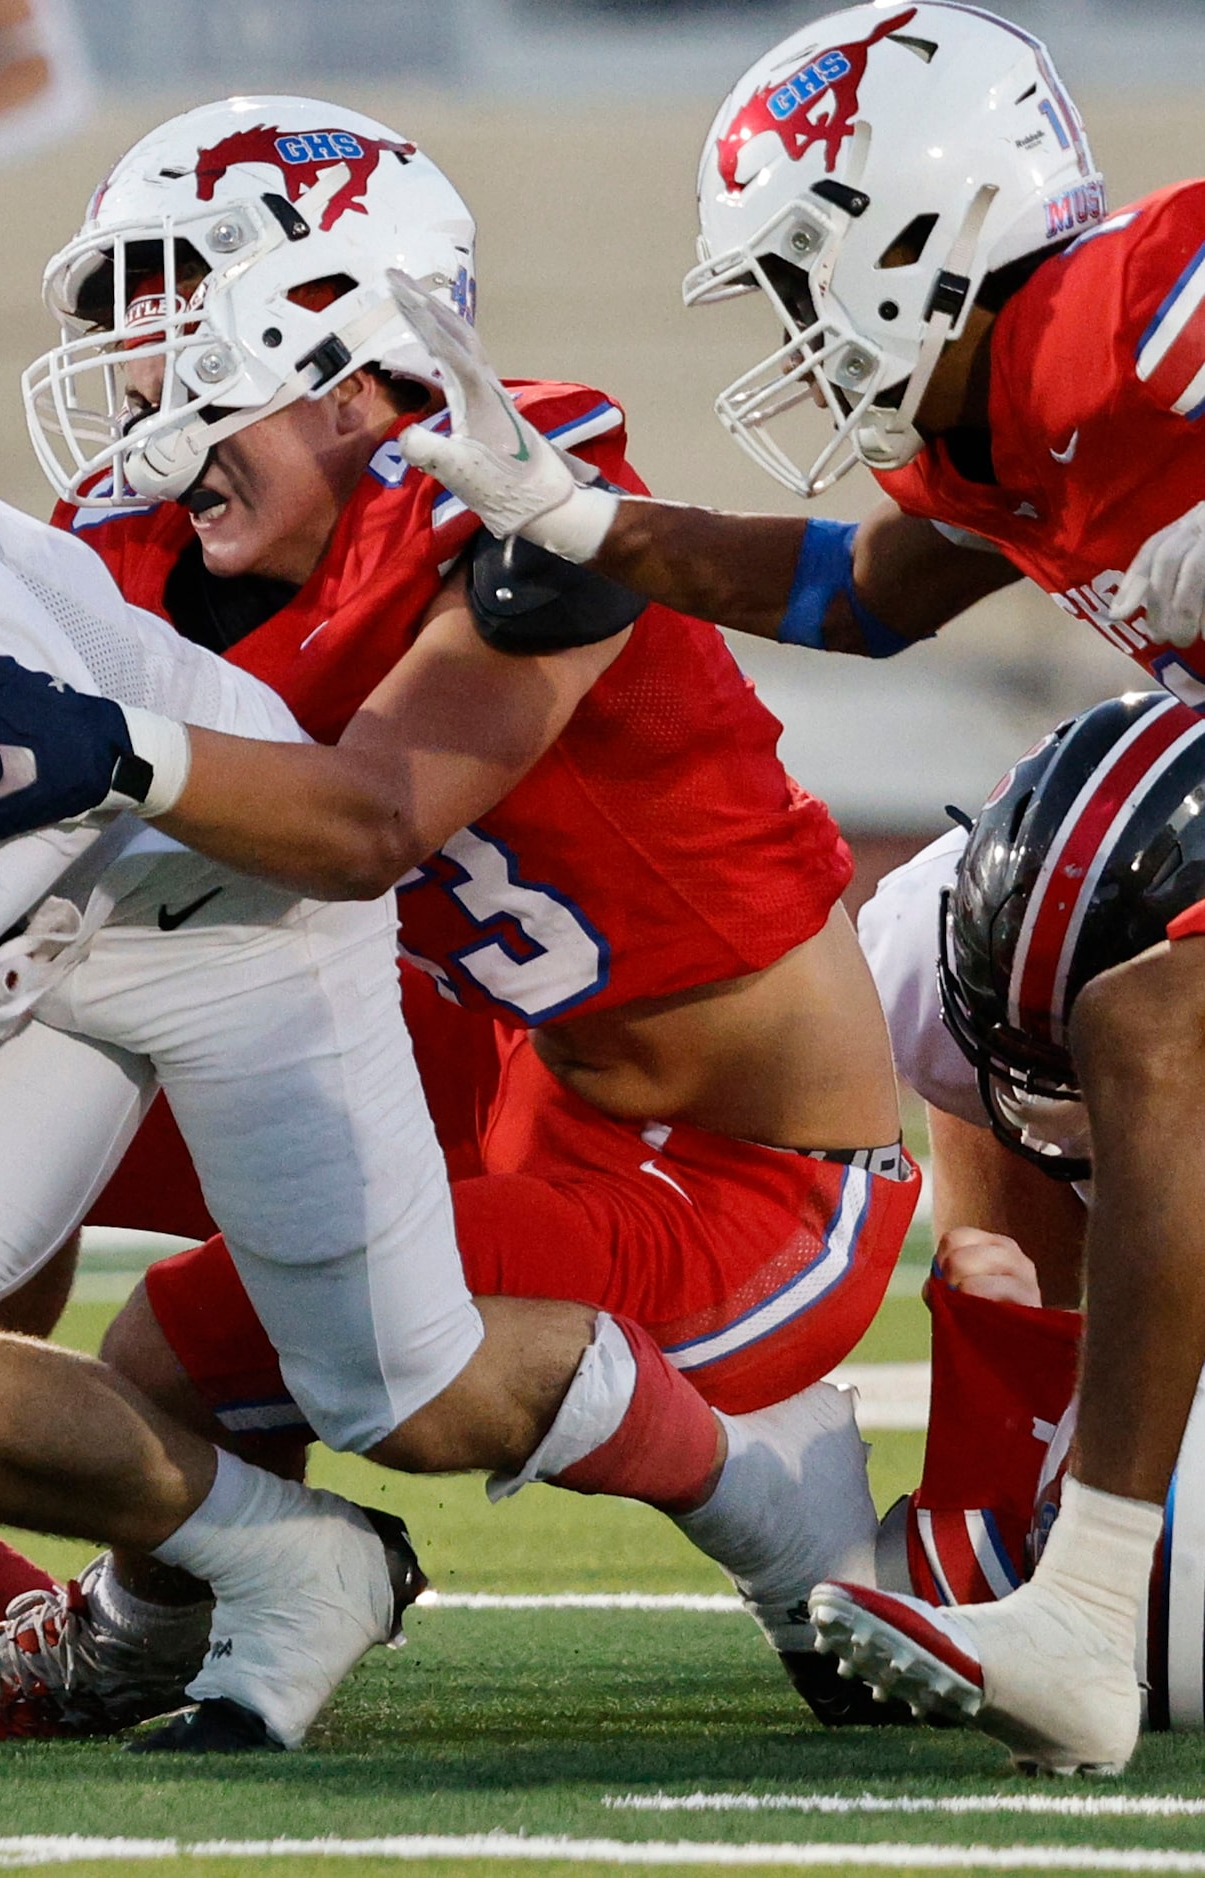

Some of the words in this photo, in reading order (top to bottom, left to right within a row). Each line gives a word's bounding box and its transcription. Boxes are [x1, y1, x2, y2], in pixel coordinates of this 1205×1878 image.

[765, 50, 852, 121] GHS
[273, 131, 365, 165] GHS
[1038, 98, 1071, 150] 1
